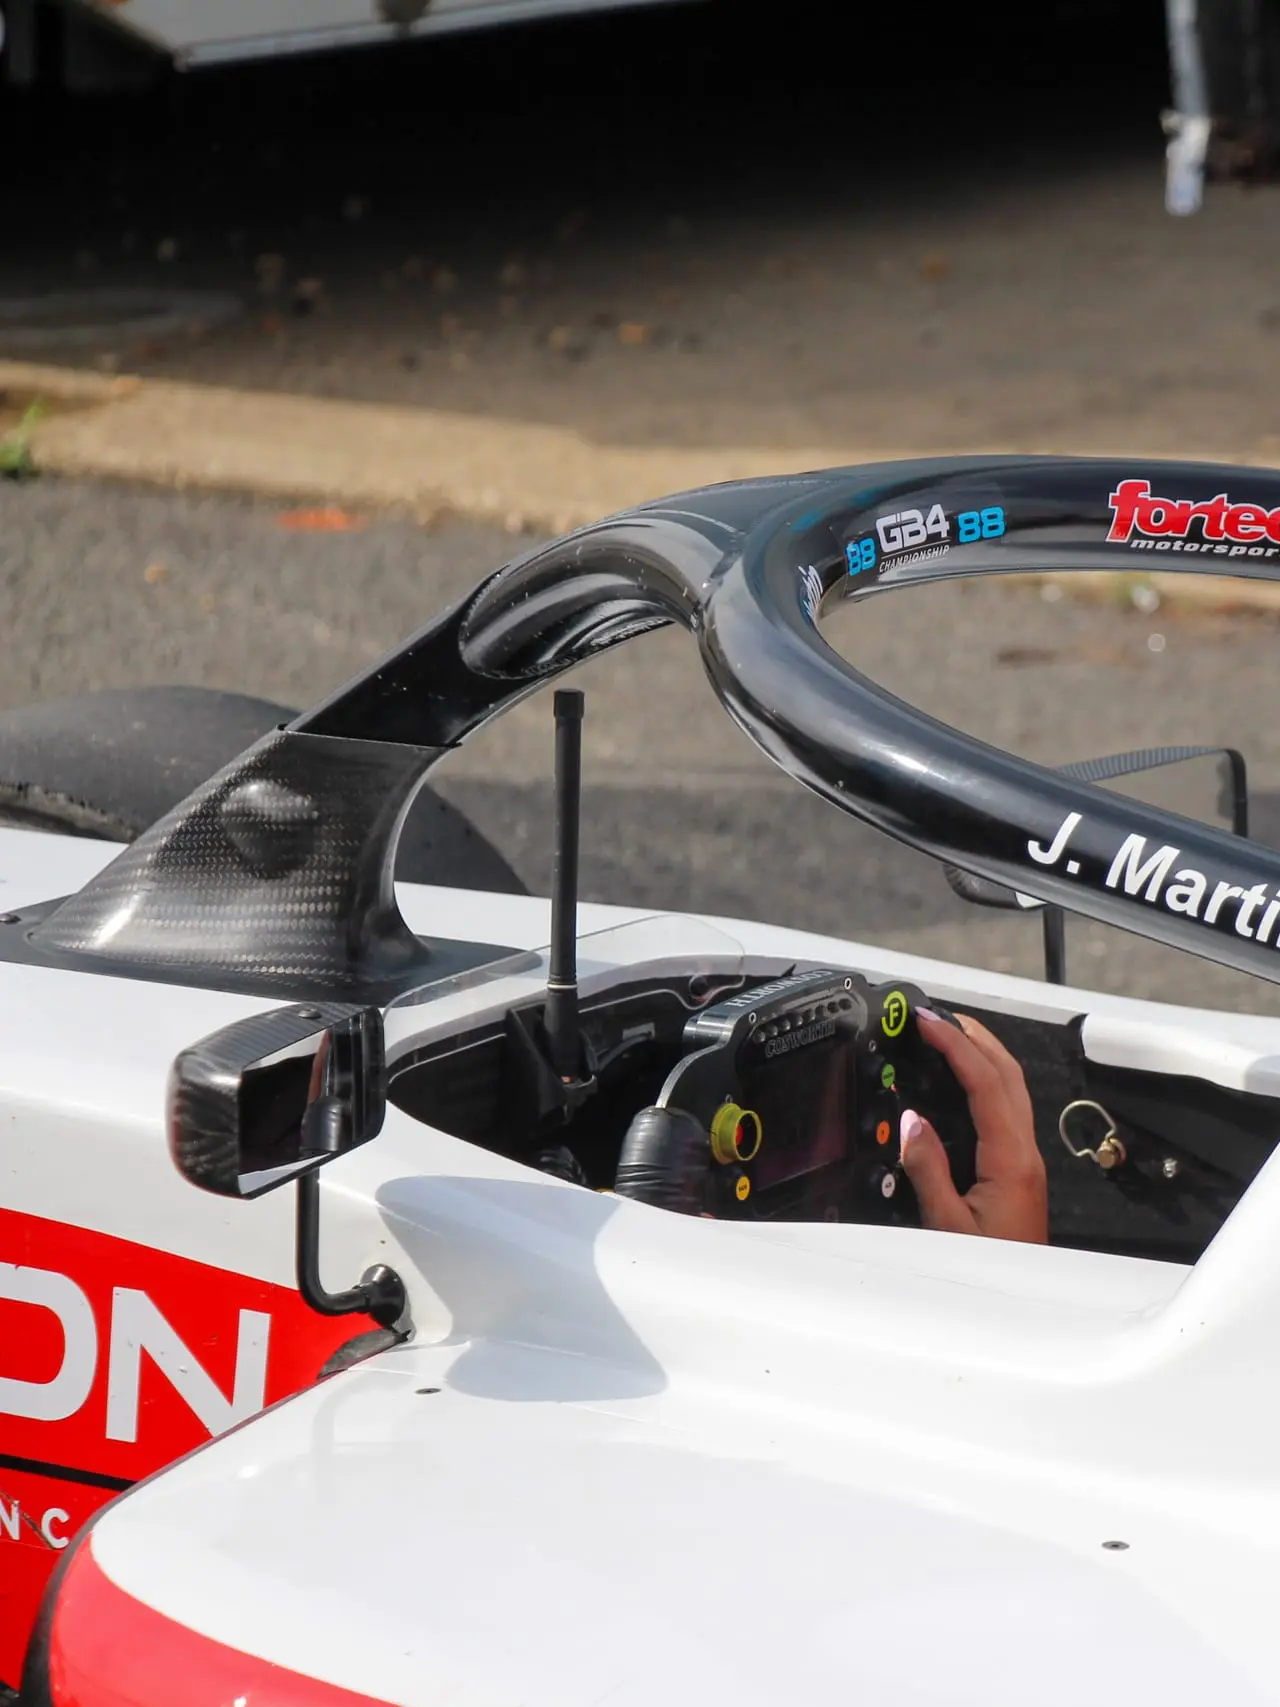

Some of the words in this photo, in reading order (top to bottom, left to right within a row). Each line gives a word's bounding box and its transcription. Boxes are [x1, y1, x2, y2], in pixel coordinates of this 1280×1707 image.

[875, 503, 951, 553] GB4
[957, 506, 1006, 543] 88
[878, 544, 951, 574] CHAMPIONSHIP
[1026, 811, 1083, 875] J.
